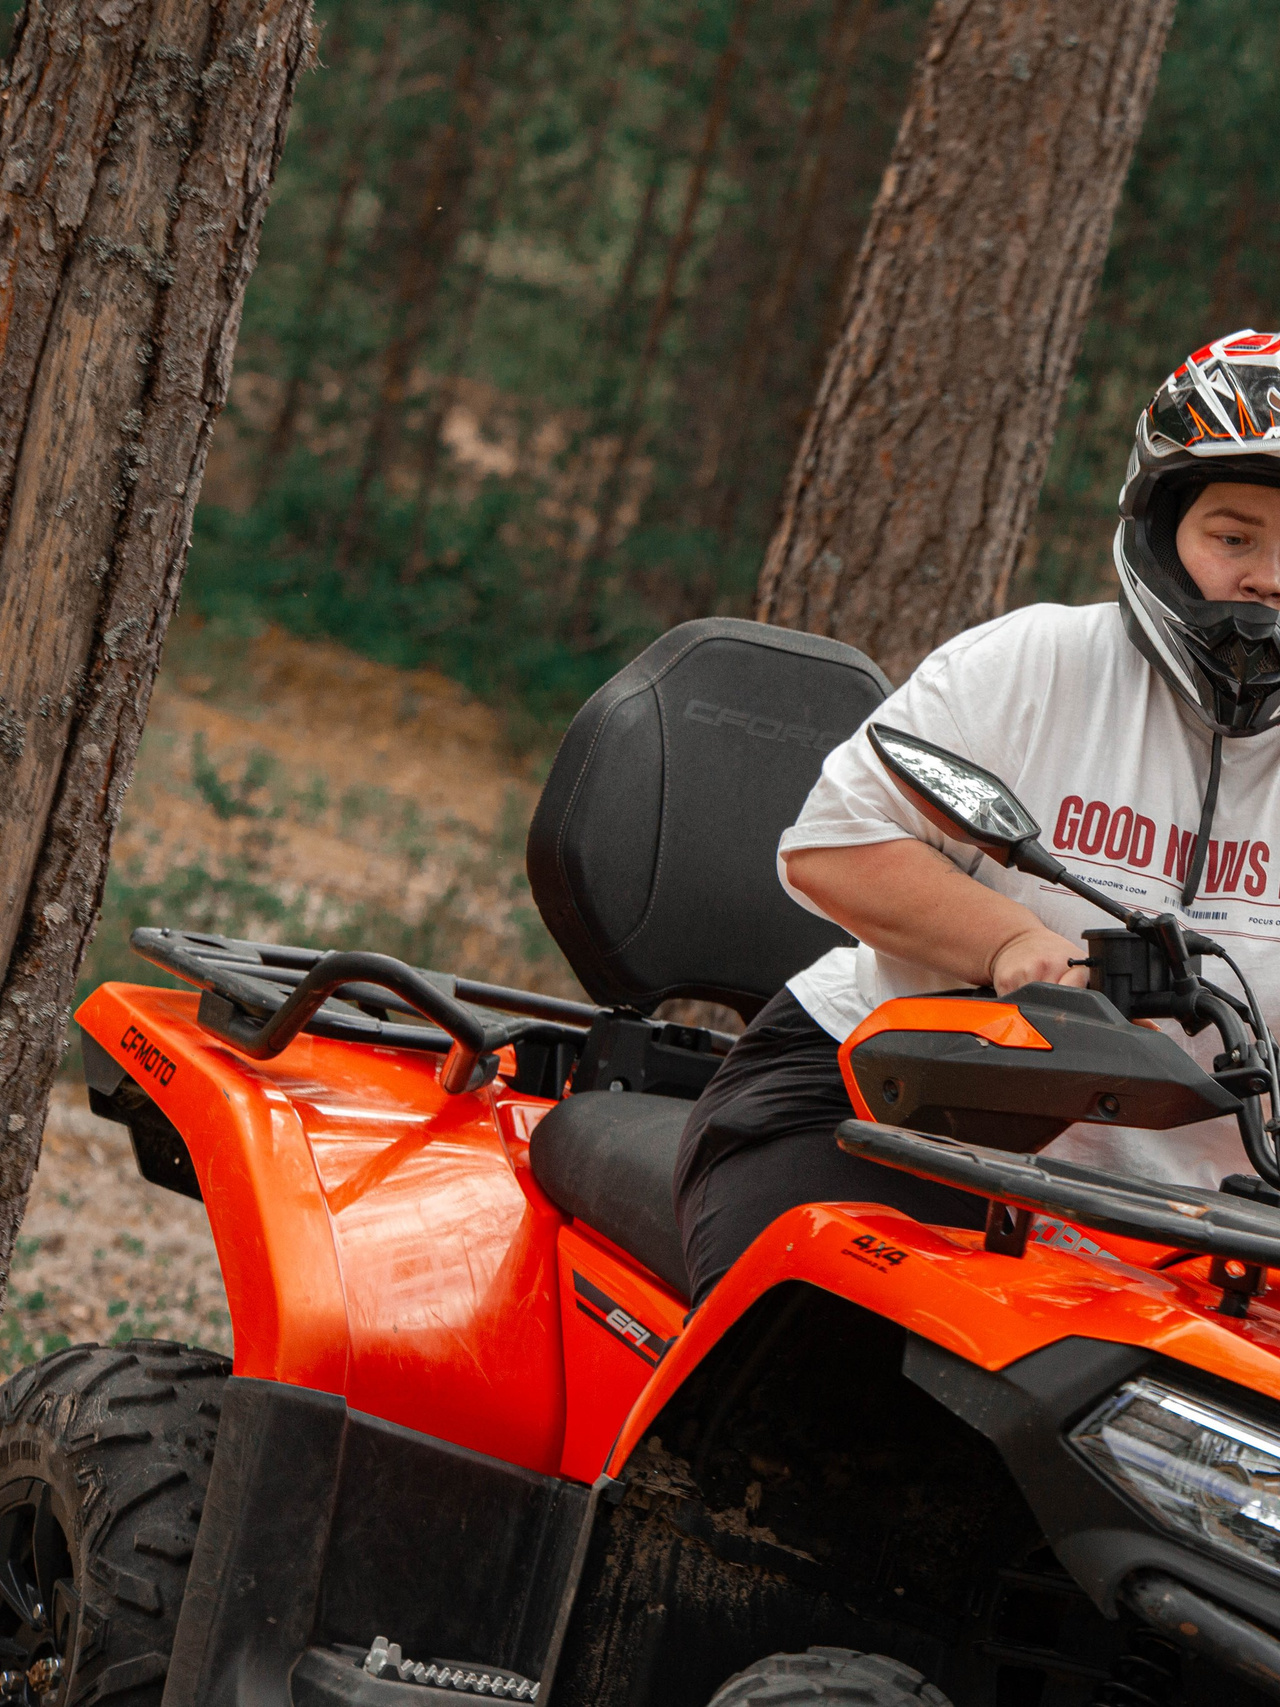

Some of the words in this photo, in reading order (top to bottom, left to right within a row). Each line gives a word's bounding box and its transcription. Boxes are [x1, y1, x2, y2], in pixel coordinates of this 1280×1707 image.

[683, 698, 848, 752] CFORC
[1052, 795, 1156, 868] GOOD
[1163, 824, 1269, 897] NWS
[1087, 877, 1124, 890] SHADOWS
[1125, 885, 1147, 896] LOOM
[1248, 916, 1274, 926] FOCUS
[120, 1025, 177, 1086] CFMOTO
[852, 1234, 909, 1266] 4X4
[606, 1308, 651, 1347] EFI
